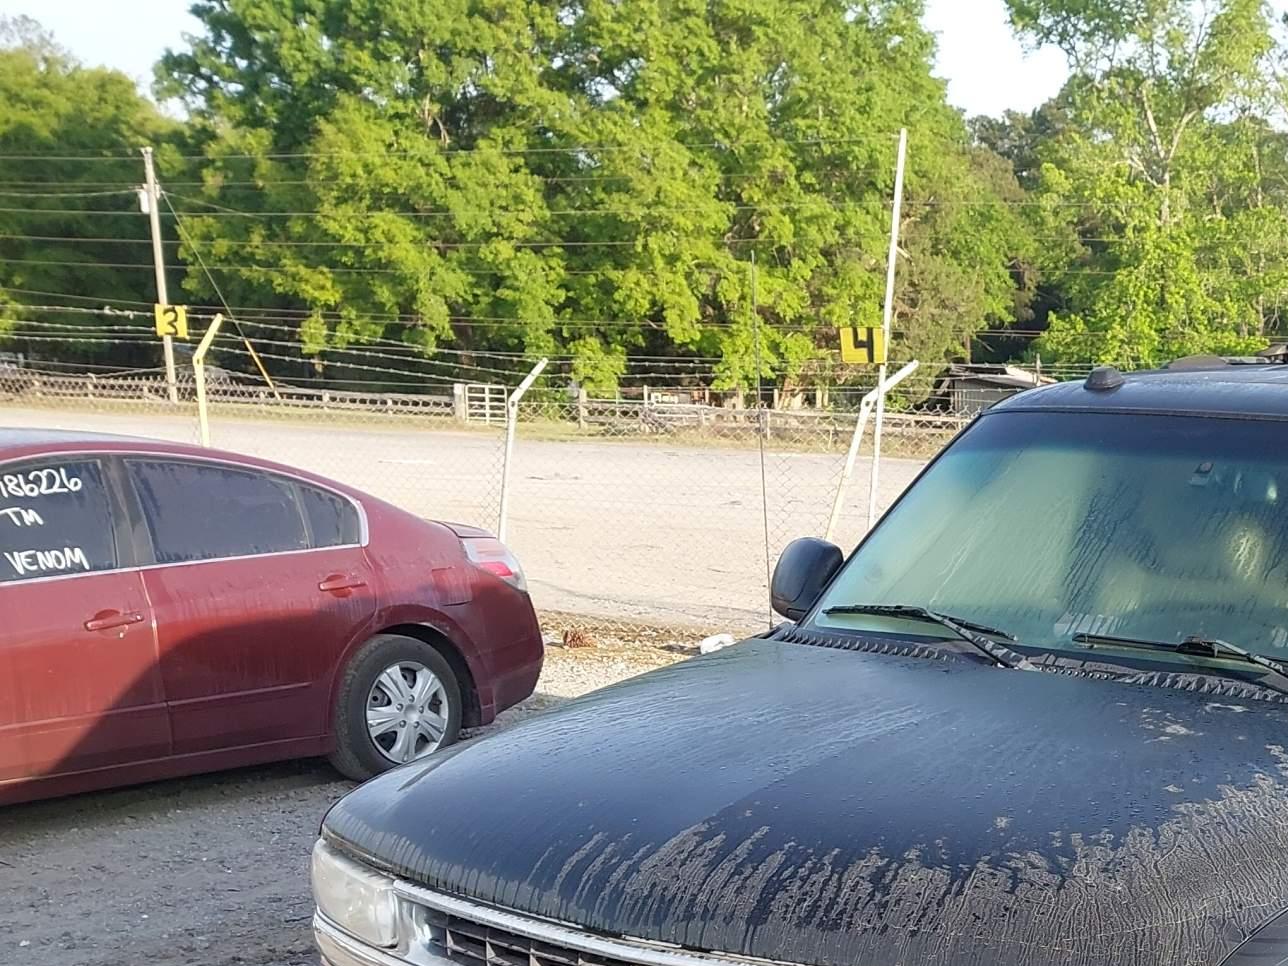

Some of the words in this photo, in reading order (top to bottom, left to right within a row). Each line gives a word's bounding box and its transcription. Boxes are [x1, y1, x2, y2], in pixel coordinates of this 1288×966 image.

[163, 306, 178, 336] 3
[852, 327, 874, 363] 4
[4, 547, 90, 575] VENOM
